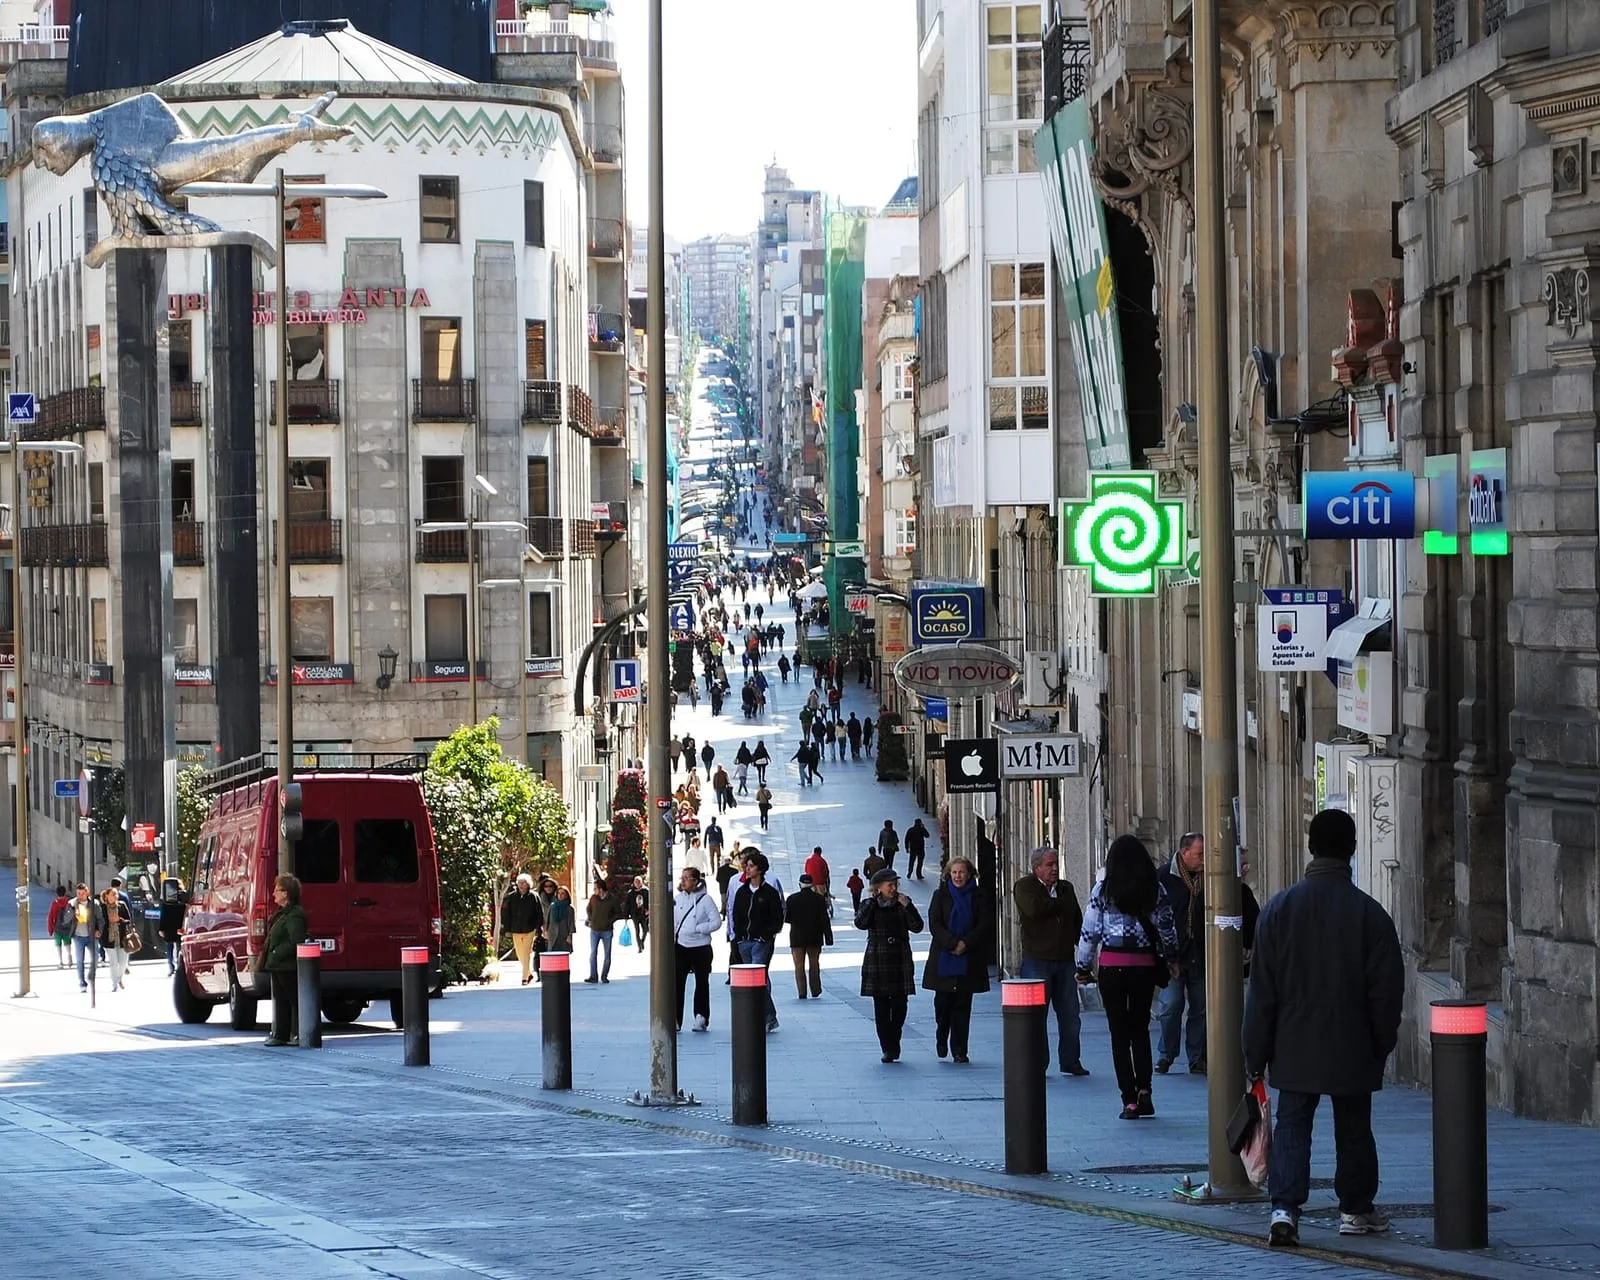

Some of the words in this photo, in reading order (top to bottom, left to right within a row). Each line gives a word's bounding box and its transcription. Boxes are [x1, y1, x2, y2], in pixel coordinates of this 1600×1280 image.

[338, 287, 431, 308] ANTA
[252, 309, 367, 325] MBILIARIA
[11, 406, 30, 417] AXA
[1327, 488, 1390, 525] citi
[923, 623, 966, 633] OCASO
[434, 665, 465, 675] Seguros
[620, 666, 631, 686] L
[906, 661, 940, 680] via
[948, 660, 1012, 680] novia
[613, 687, 638, 699] FARO
